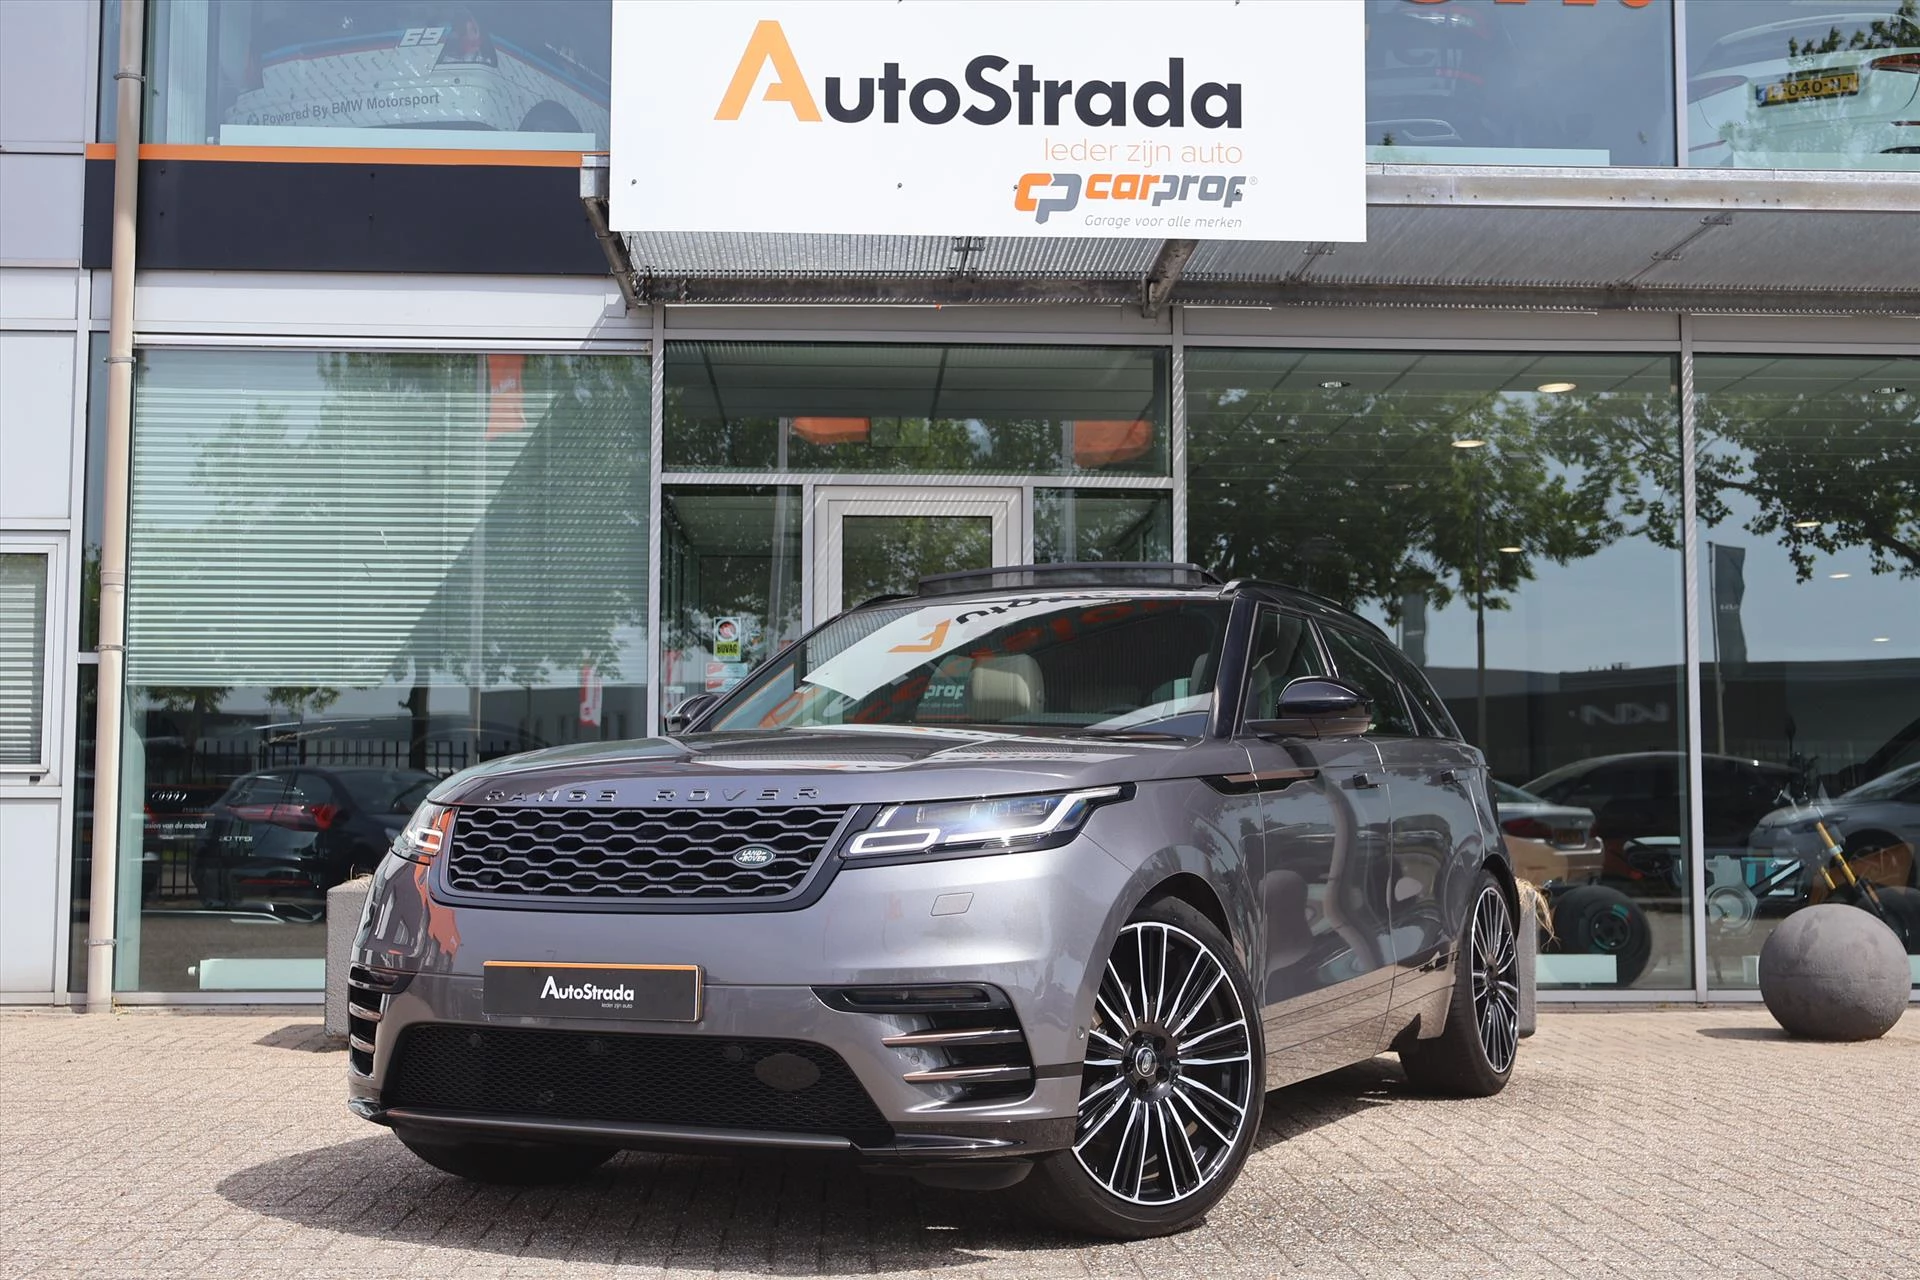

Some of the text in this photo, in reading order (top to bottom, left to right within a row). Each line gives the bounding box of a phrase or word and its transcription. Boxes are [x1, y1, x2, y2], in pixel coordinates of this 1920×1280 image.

[400, 27, 445, 47] 69
[713, 20, 1243, 129] AutoStrada
[262, 92, 440, 126] Powered By BMW Motorsport
[1127, 140, 1171, 168] zijn
[1181, 142, 1243, 164] auto
[1085, 214, 1243, 228] Garage voor alle merken
[485, 786, 821, 802] RANGE ROVER
[540, 975, 635, 1001] AutoStrada
